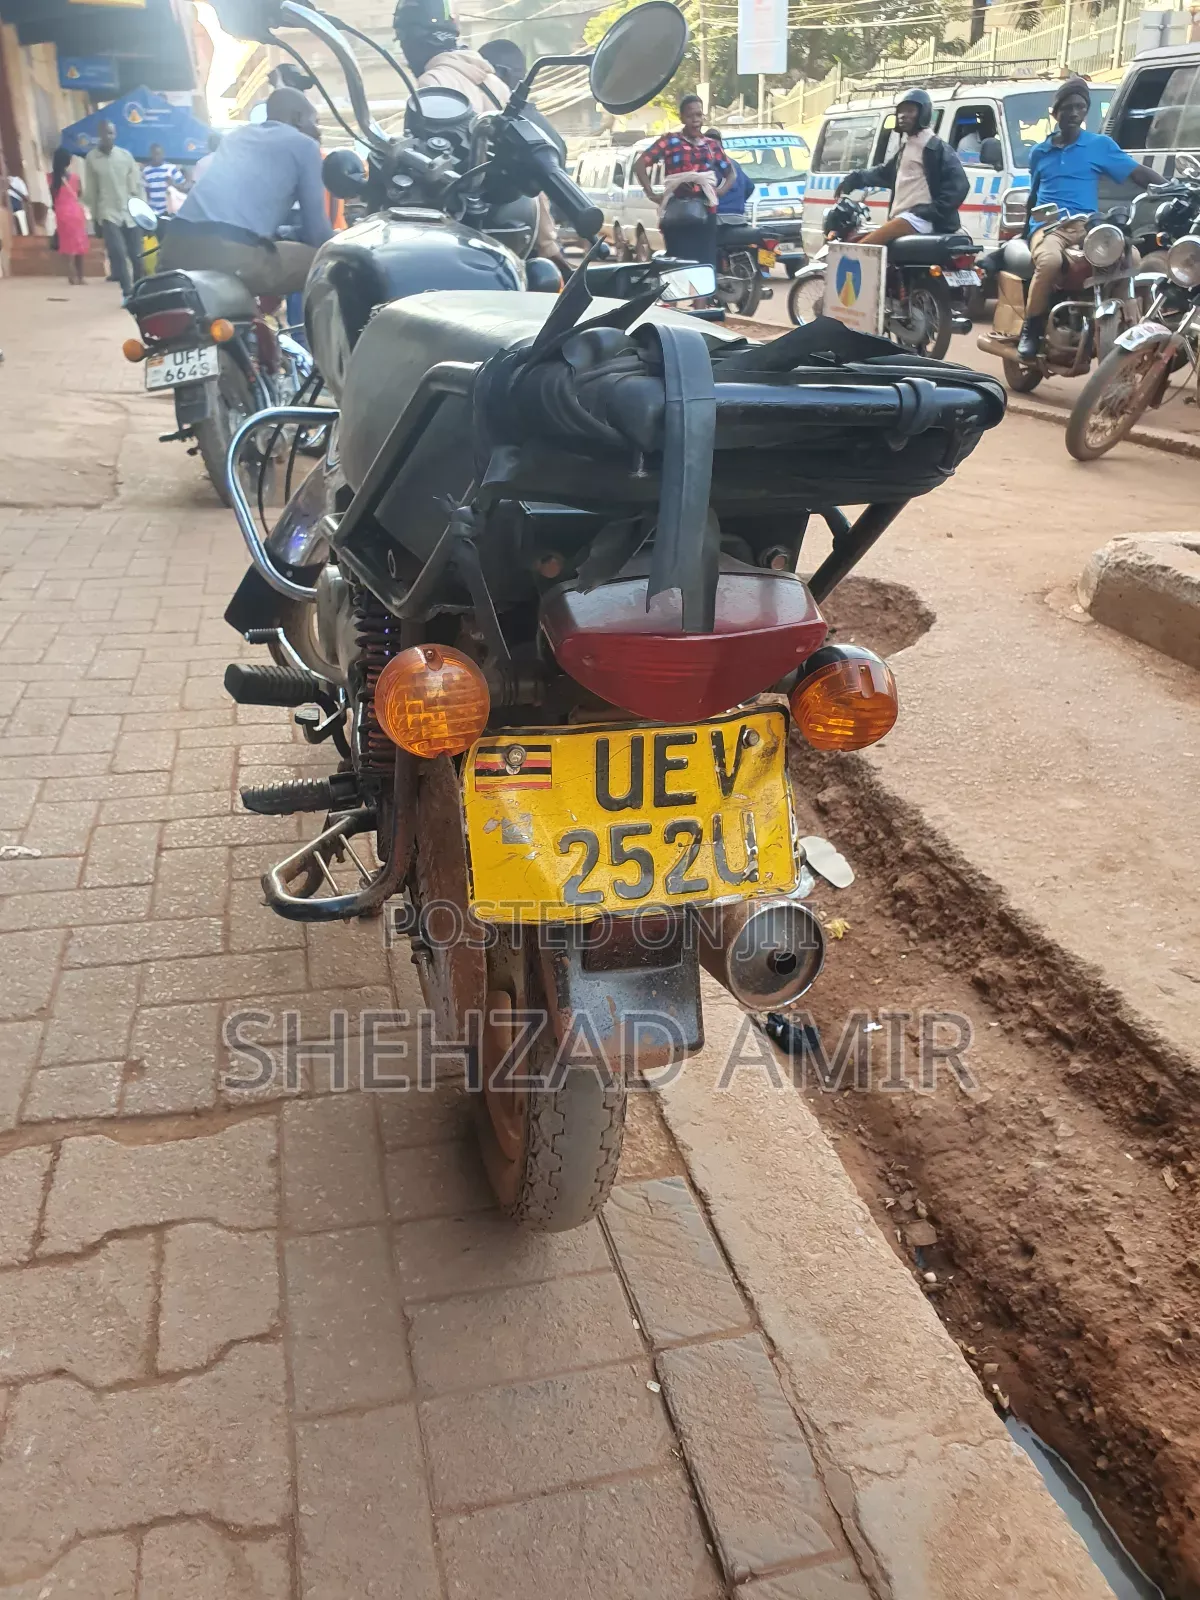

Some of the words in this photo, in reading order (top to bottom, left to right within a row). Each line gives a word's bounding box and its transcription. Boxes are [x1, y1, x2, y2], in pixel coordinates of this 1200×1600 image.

[722, 135, 801, 149] ISMILLAH
[595, 724, 748, 812] UEV
[558, 812, 760, 907] 252U
